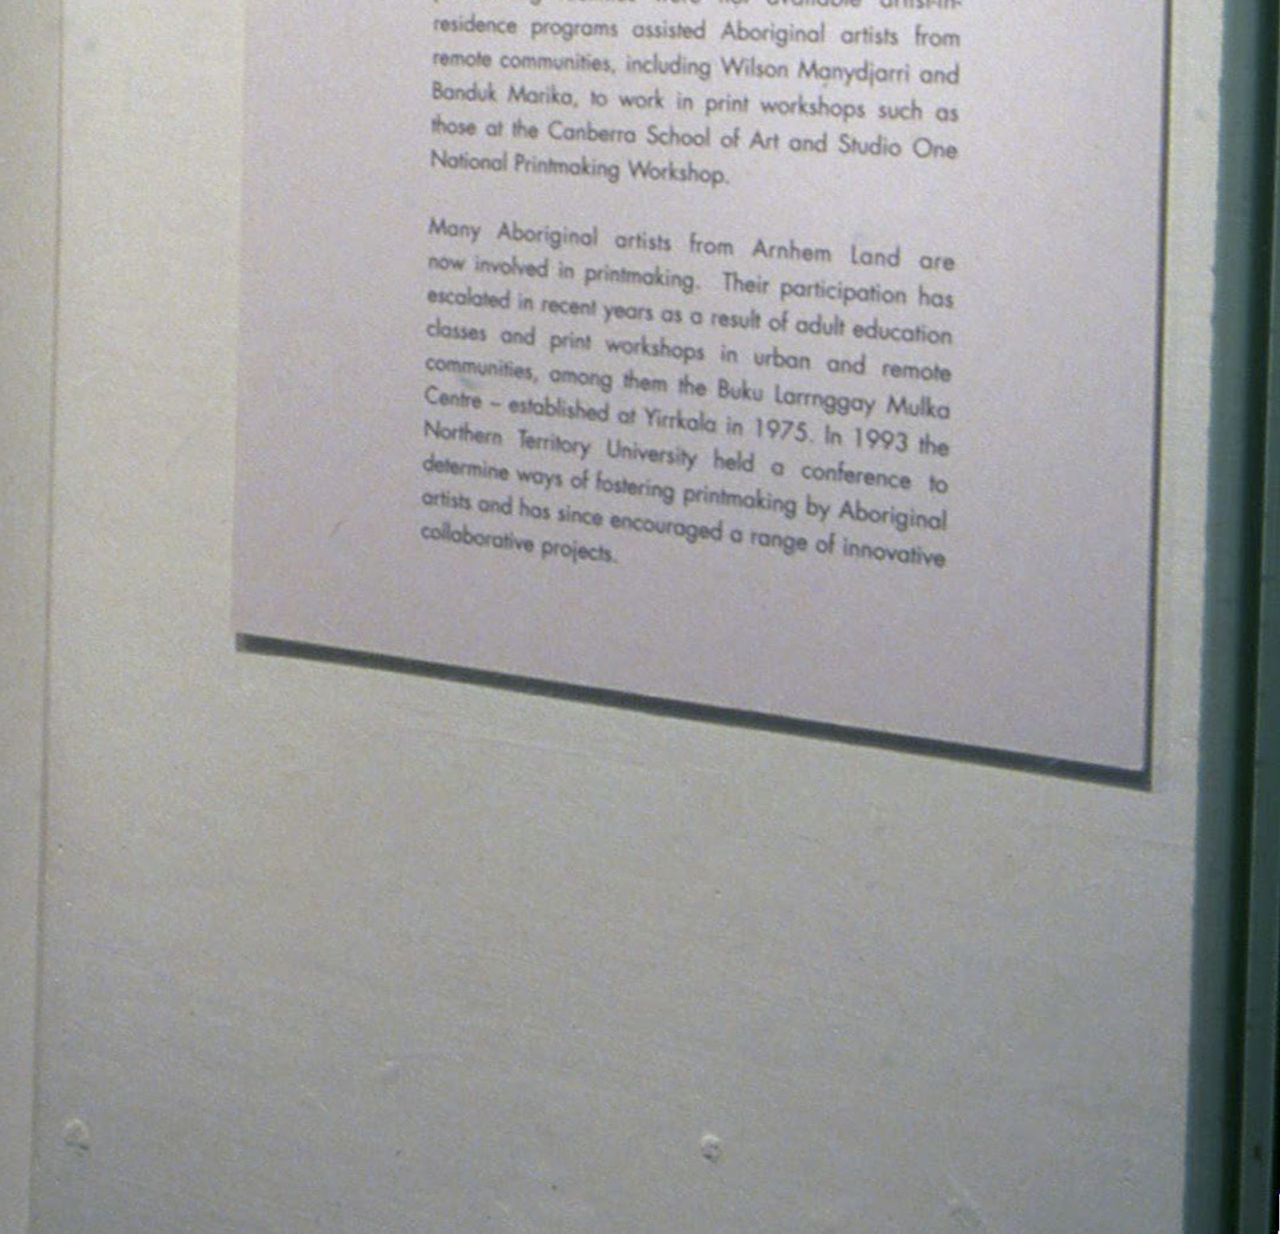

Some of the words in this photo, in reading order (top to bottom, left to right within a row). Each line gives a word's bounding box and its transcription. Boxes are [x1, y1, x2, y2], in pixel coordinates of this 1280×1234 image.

[433, 13, 517, 34] residence
[531, 21, 618, 41] programs
[632, 19, 706, 39] assisted
[721, 20, 825, 48] Aboriginal
[841, 26, 898, 45] artists
[915, 24, 960, 47] from
[433, 52, 492, 67] remote
[500, 54, 615, 74] communities,
[626, 53, 711, 81] including
[721, 57, 788, 78] Wilson
[798, 60, 910, 87] Manydjarri
[920, 63, 960, 85] and
[432, 80, 496, 101] Banduk
[508, 85, 578, 107] Marika,
[619, 89, 664, 109] work
[705, 94, 749, 116] print
[760, 94, 865, 122] workshops
[879, 98, 922, 120] such
[431, 114, 476, 135] those
[512, 118, 539, 139] the
[548, 120, 636, 143] Canberra
[647, 124, 710, 146] School
[720, 127, 740, 148] of
[749, 130, 779, 149] Art
[789, 132, 827, 153] and
[839, 133, 902, 157] Studio
[912, 137, 958, 160] One
[431, 149, 507, 172] National
[514, 153, 620, 184] Printmaking
[628, 160, 729, 188] Workshop.
[428, 217, 481, 243] Many
[497, 221, 598, 250] Aboriginal
[615, 232, 671, 252] artists
[690, 232, 733, 255] from
[752, 238, 831, 262] Arnhem
[851, 244, 901, 267] Land
[919, 255, 955, 271] are
[428, 256, 465, 270] now
[475, 256, 549, 278] involved
[585, 265, 699, 295] printmaking.
[723, 271, 769, 293] Their
[780, 281, 907, 306] participation
[919, 285, 954, 309] has
[427, 287, 510, 309] escalated
[542, 300, 597, 315] recent
[604, 306, 653, 323] years
[711, 309, 761, 329] result
[768, 310, 788, 332] of
[795, 314, 845, 336] adult
[852, 318, 953, 345] education
[426, 318, 487, 341] classes
[500, 326, 536, 345] and
[550, 333, 591, 353] print
[606, 336, 705, 364] workshops
[754, 347, 810, 369] urban
[826, 354, 866, 375] and
[882, 363, 952, 383] remote
[425, 358, 537, 382] communities,
[549, 370, 613, 393] among
[623, 369, 667, 391] them
[679, 374, 707, 396] the
[718, 378, 763, 402] Buku
[775, 384, 876, 417] Larrnggay
[887, 395, 950, 420] Mulka
[424, 385, 482, 409] Centre
[508, 397, 609, 422] established
[645, 408, 716, 433] Yirrkala
[757, 418, 813, 442] 1975.
[856, 428, 908, 453] 1993
[919, 433, 950, 457] the
[424, 420, 502, 444] Northern
[519, 428, 591, 460] Territory
[607, 439, 697, 471] University
[714, 448, 755, 472] held
[801, 461, 911, 490] conference
[422, 453, 509, 481] determine
[517, 470, 563, 490] ways
[570, 469, 589, 489] of
[596, 471, 675, 505] fostering
[683, 486, 797, 520] printmaking
[806, 495, 830, 522] by
[838, 500, 947, 532] Aboriginal
[421, 522, 534, 552] collaborative
[541, 541, 616, 563] projects.
[422, 492, 471, 510] artists
[478, 496, 512, 515] and
[519, 498, 550, 520] has
[558, 506, 603, 526] since
[610, 515, 723, 544] encouraged
[751, 532, 808, 556] range
[815, 532, 835, 554] of
[843, 538, 946, 568] innovative
